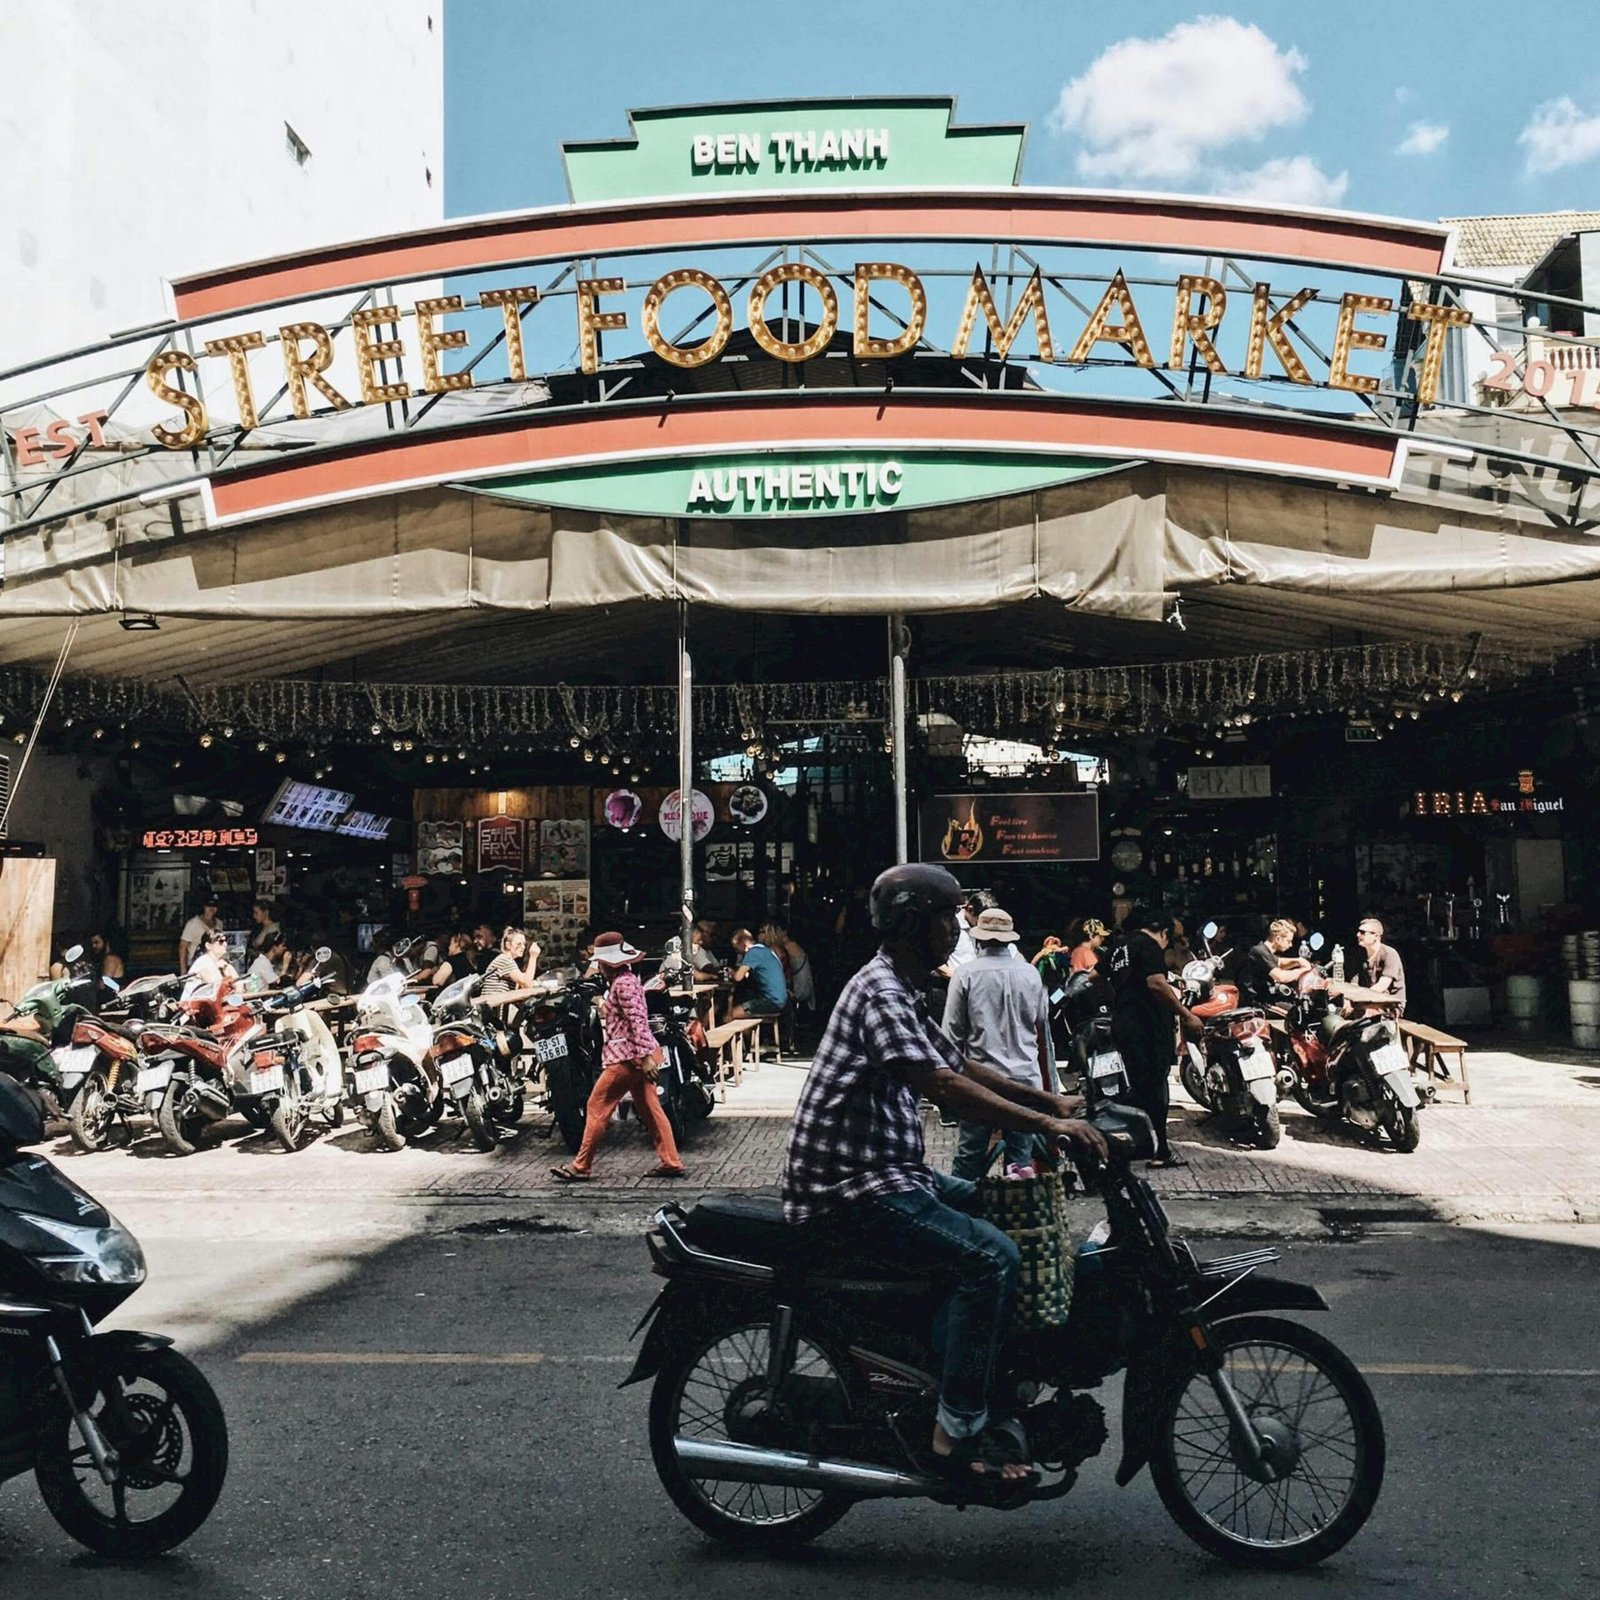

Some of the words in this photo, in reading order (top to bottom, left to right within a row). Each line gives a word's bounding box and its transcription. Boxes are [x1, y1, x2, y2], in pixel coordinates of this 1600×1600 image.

[693, 132, 761, 167] BEN
[770, 127, 890, 165] THANH
[147, 285, 540, 450] STREET
[576, 261, 928, 375] FOOD
[950, 261, 1473, 405] MARKET
[15, 409, 110, 467] EST
[687, 460, 904, 504] AUTHENTIC
[1519, 796, 1564, 813] Miguel
[481, 842, 510, 855] FRY
